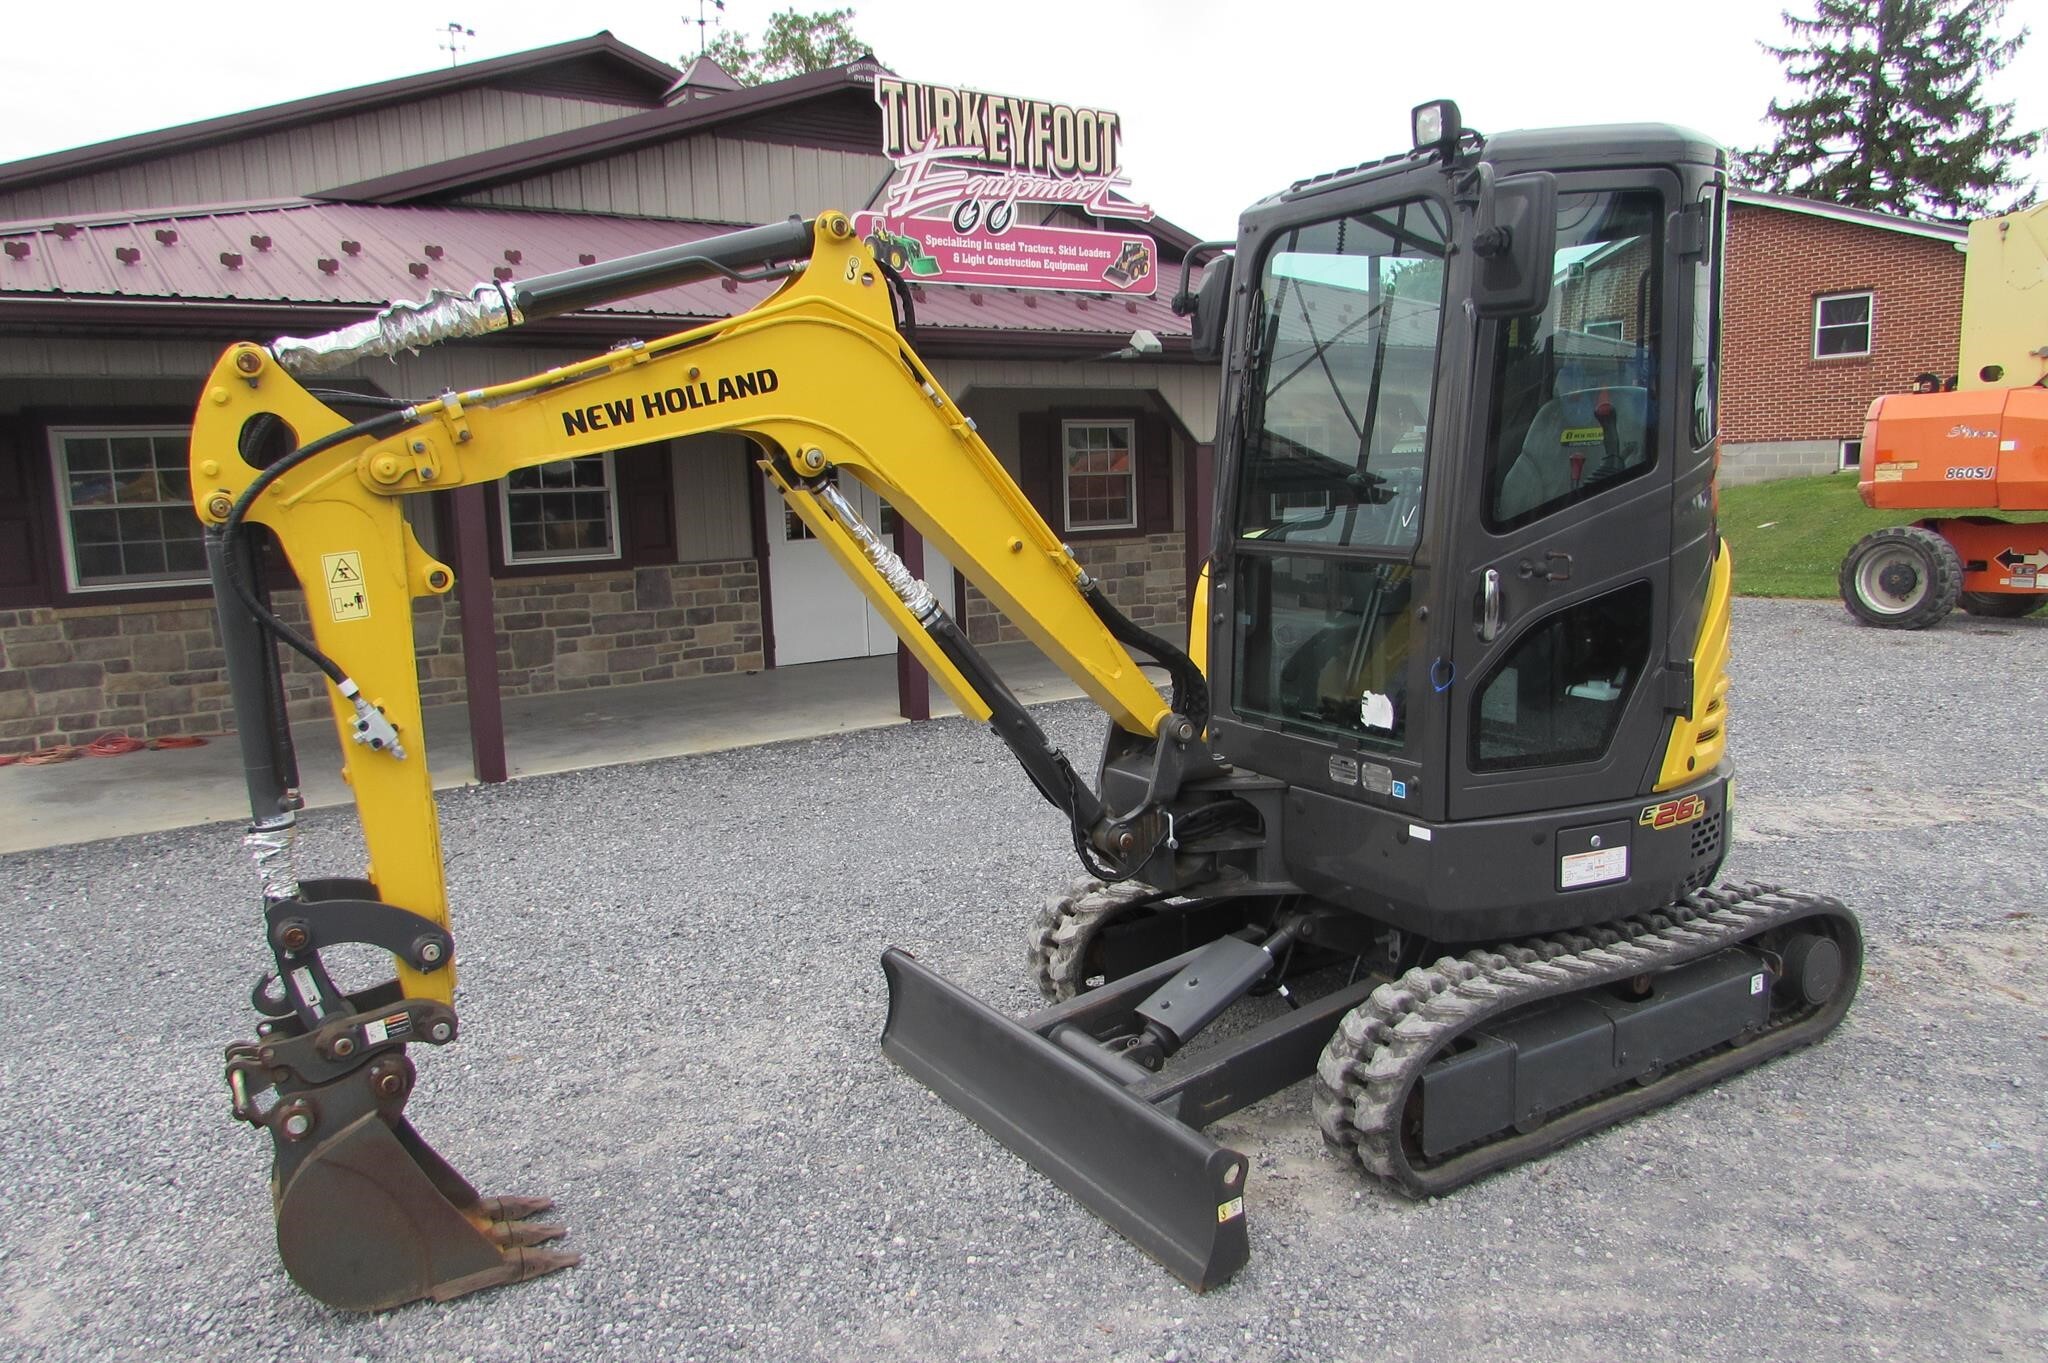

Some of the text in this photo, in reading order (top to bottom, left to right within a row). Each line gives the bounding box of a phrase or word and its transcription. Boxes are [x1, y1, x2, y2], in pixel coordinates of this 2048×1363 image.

[880, 79, 1119, 176] TURKEYFOOT
[889, 137, 1152, 222] Equipment
[925, 234, 982, 251] Specializing
[984, 238, 993, 250] in
[995, 240, 1016, 252] used
[1058, 245, 1077, 257] Skid
[1079, 246, 1112, 259] Loaders
[953, 252, 1089, 272] & Light Construction Equipment
[561, 368, 779, 437] NEW HOLLAND
[1945, 467, 1994, 480] 860SJ
